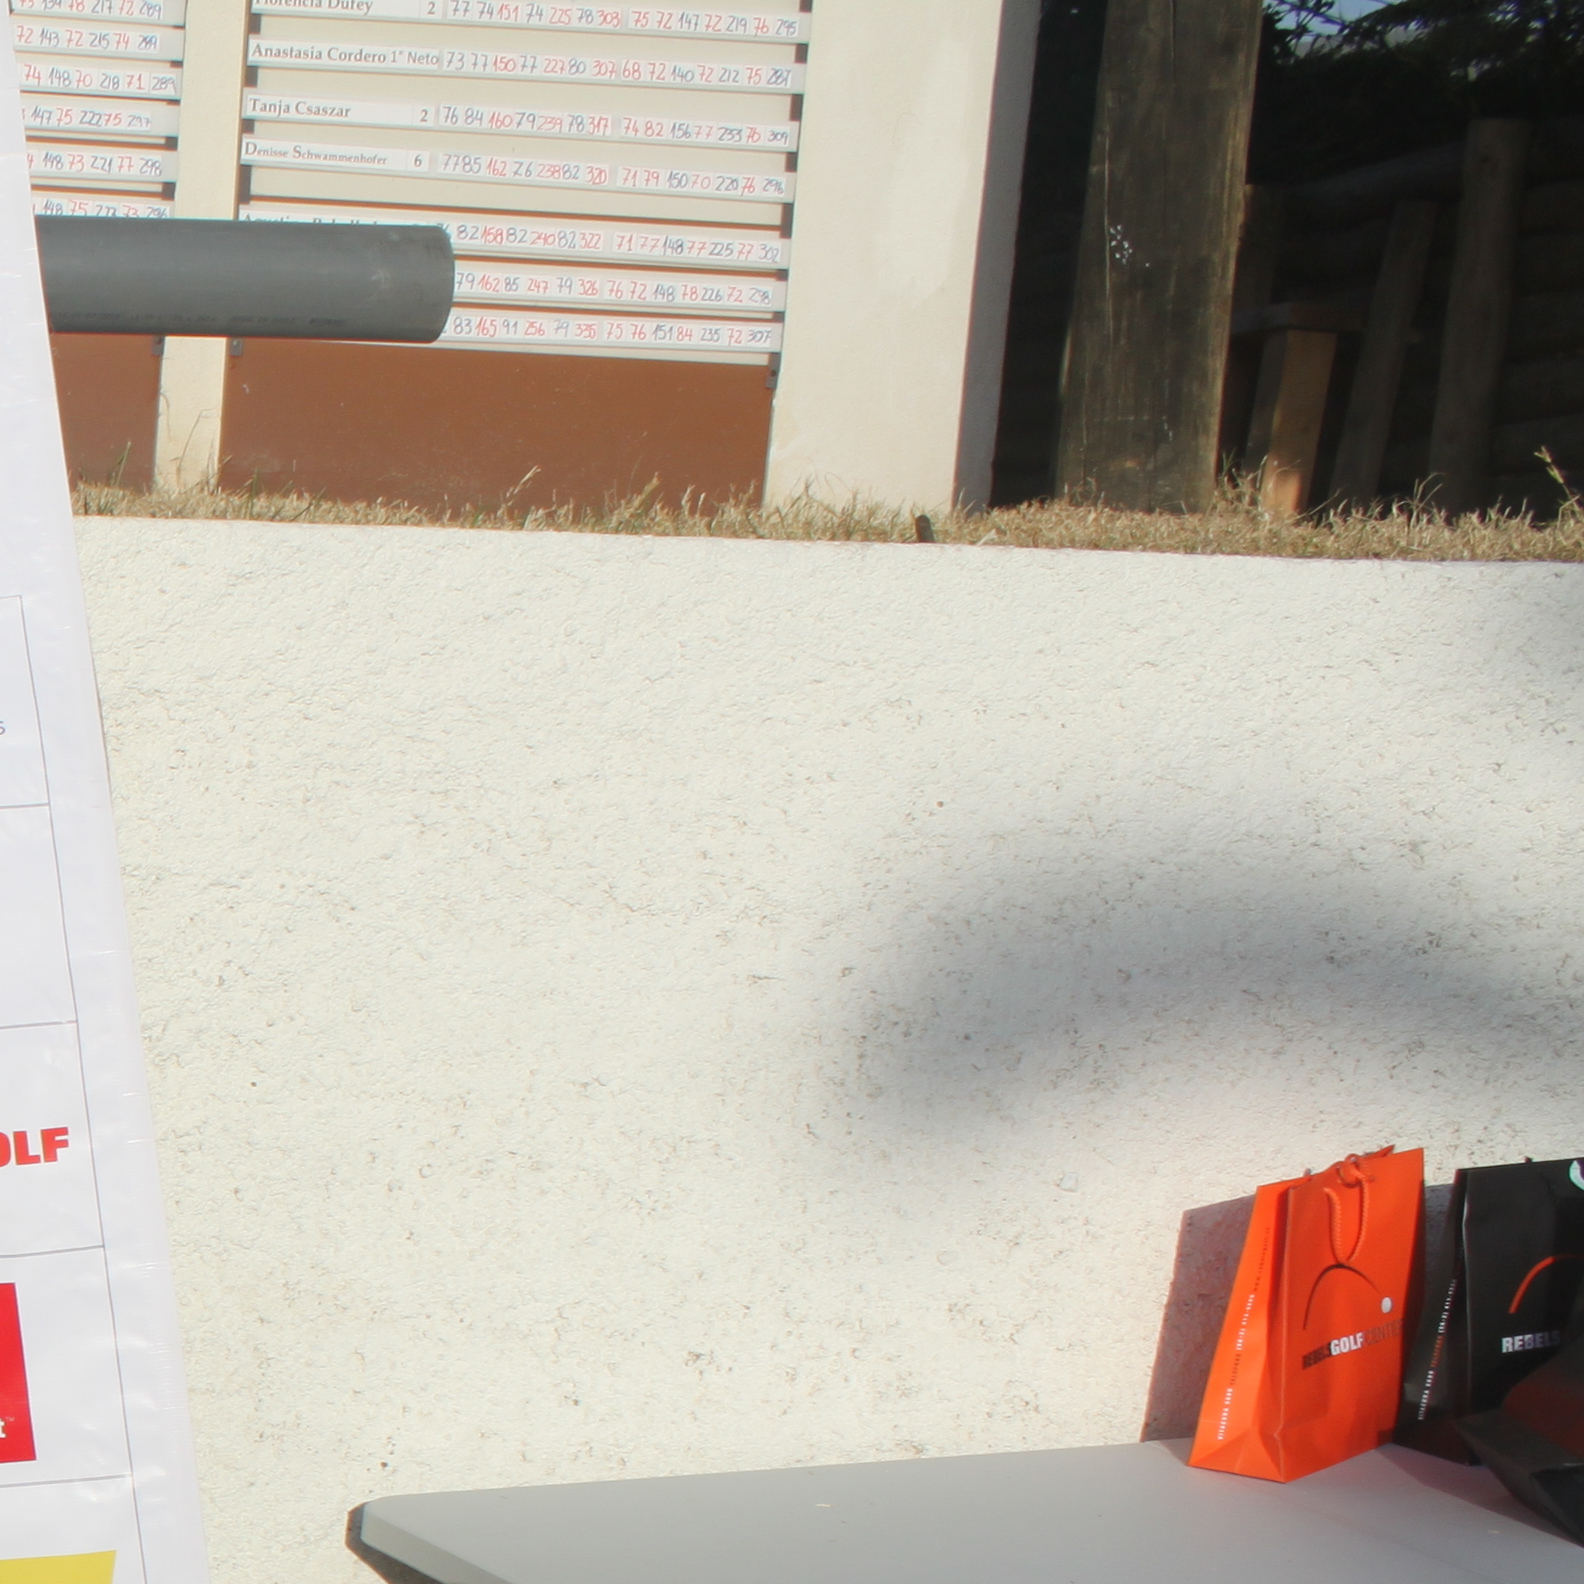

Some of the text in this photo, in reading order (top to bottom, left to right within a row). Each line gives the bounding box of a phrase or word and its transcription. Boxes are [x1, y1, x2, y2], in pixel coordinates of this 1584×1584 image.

[252, 43, 323, 61] Anastasia
[327, 47, 387, 64] Cordero
[408, 51, 440, 66] Neto
[445, 51, 616, 79] 73 77 150 77 227 80 307
[249, 98, 291, 118] Tanja
[419, 109, 428, 123] 2
[414, 154, 423, 168] 6
